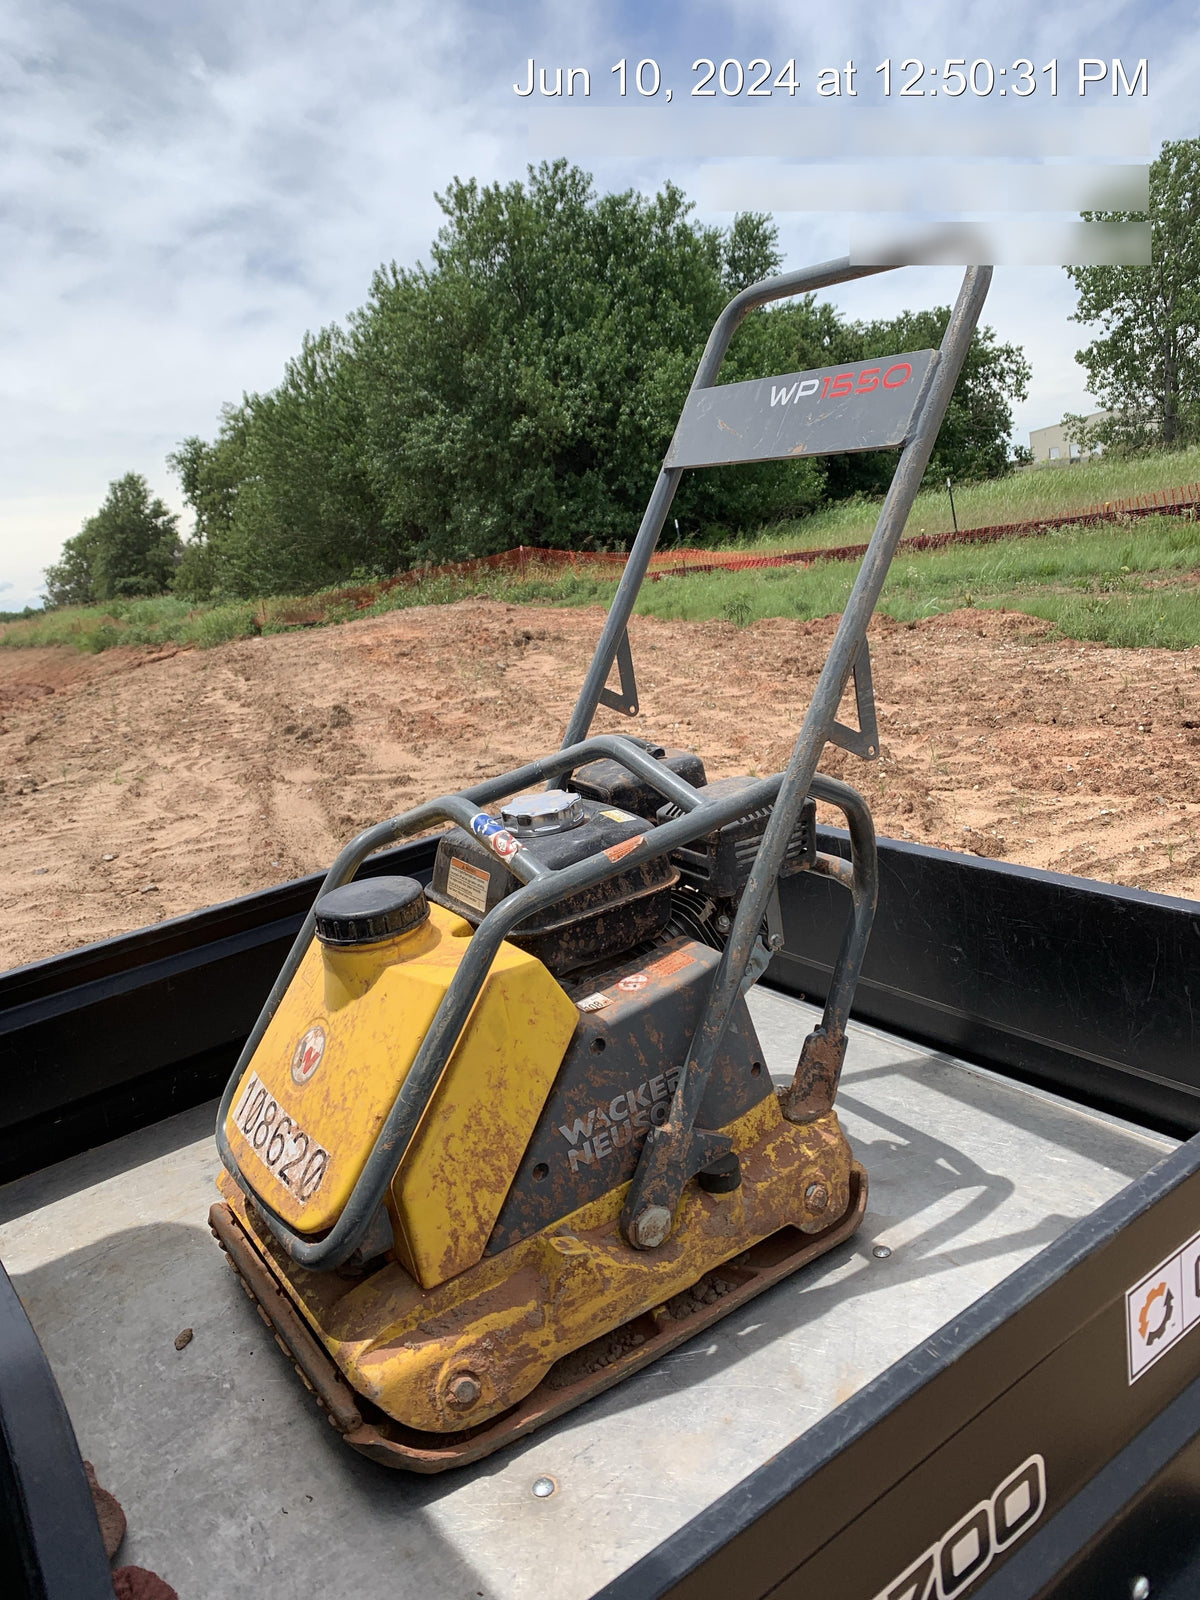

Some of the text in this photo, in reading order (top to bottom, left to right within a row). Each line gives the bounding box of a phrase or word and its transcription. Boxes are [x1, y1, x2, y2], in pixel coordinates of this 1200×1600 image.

[769, 363, 912, 407] WP1550
[236, 1077, 331, 1202] 108620
[558, 1065, 682, 1146] WACKER
[567, 1100, 671, 1173] NEUSO
